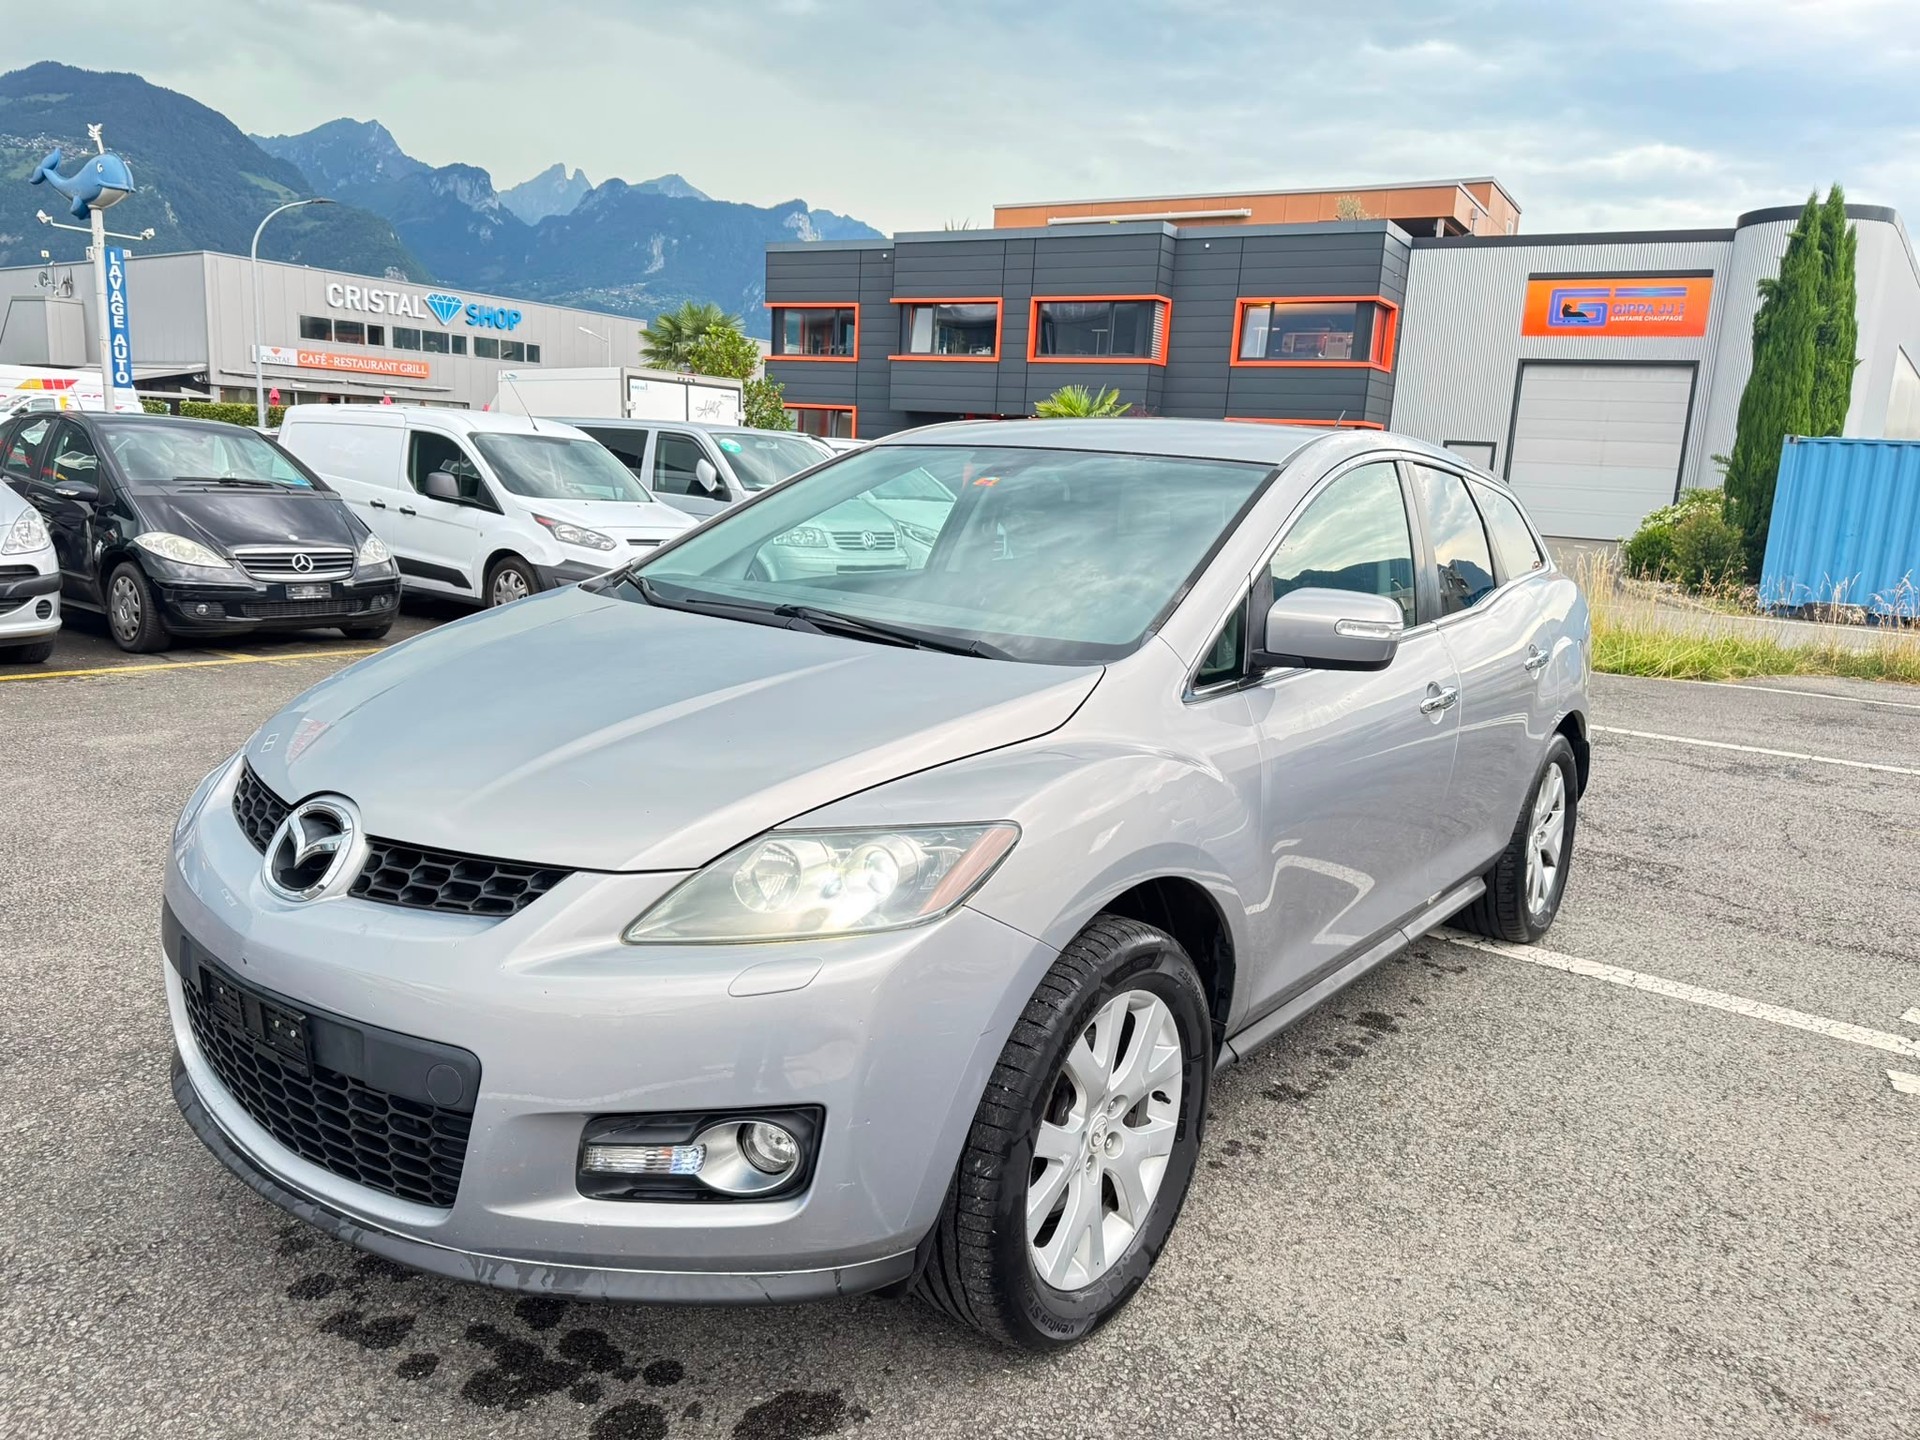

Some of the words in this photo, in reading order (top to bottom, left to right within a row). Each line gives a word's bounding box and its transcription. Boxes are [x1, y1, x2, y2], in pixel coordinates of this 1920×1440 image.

[108, 251, 124, 328] LAVAGE
[326, 283, 427, 319] CRISTAL
[465, 303, 522, 331] SHOP
[113, 333, 129, 384] AUTO
[299, 353, 328, 365] CAFÉ
[399, 363, 427, 374] GRILL
